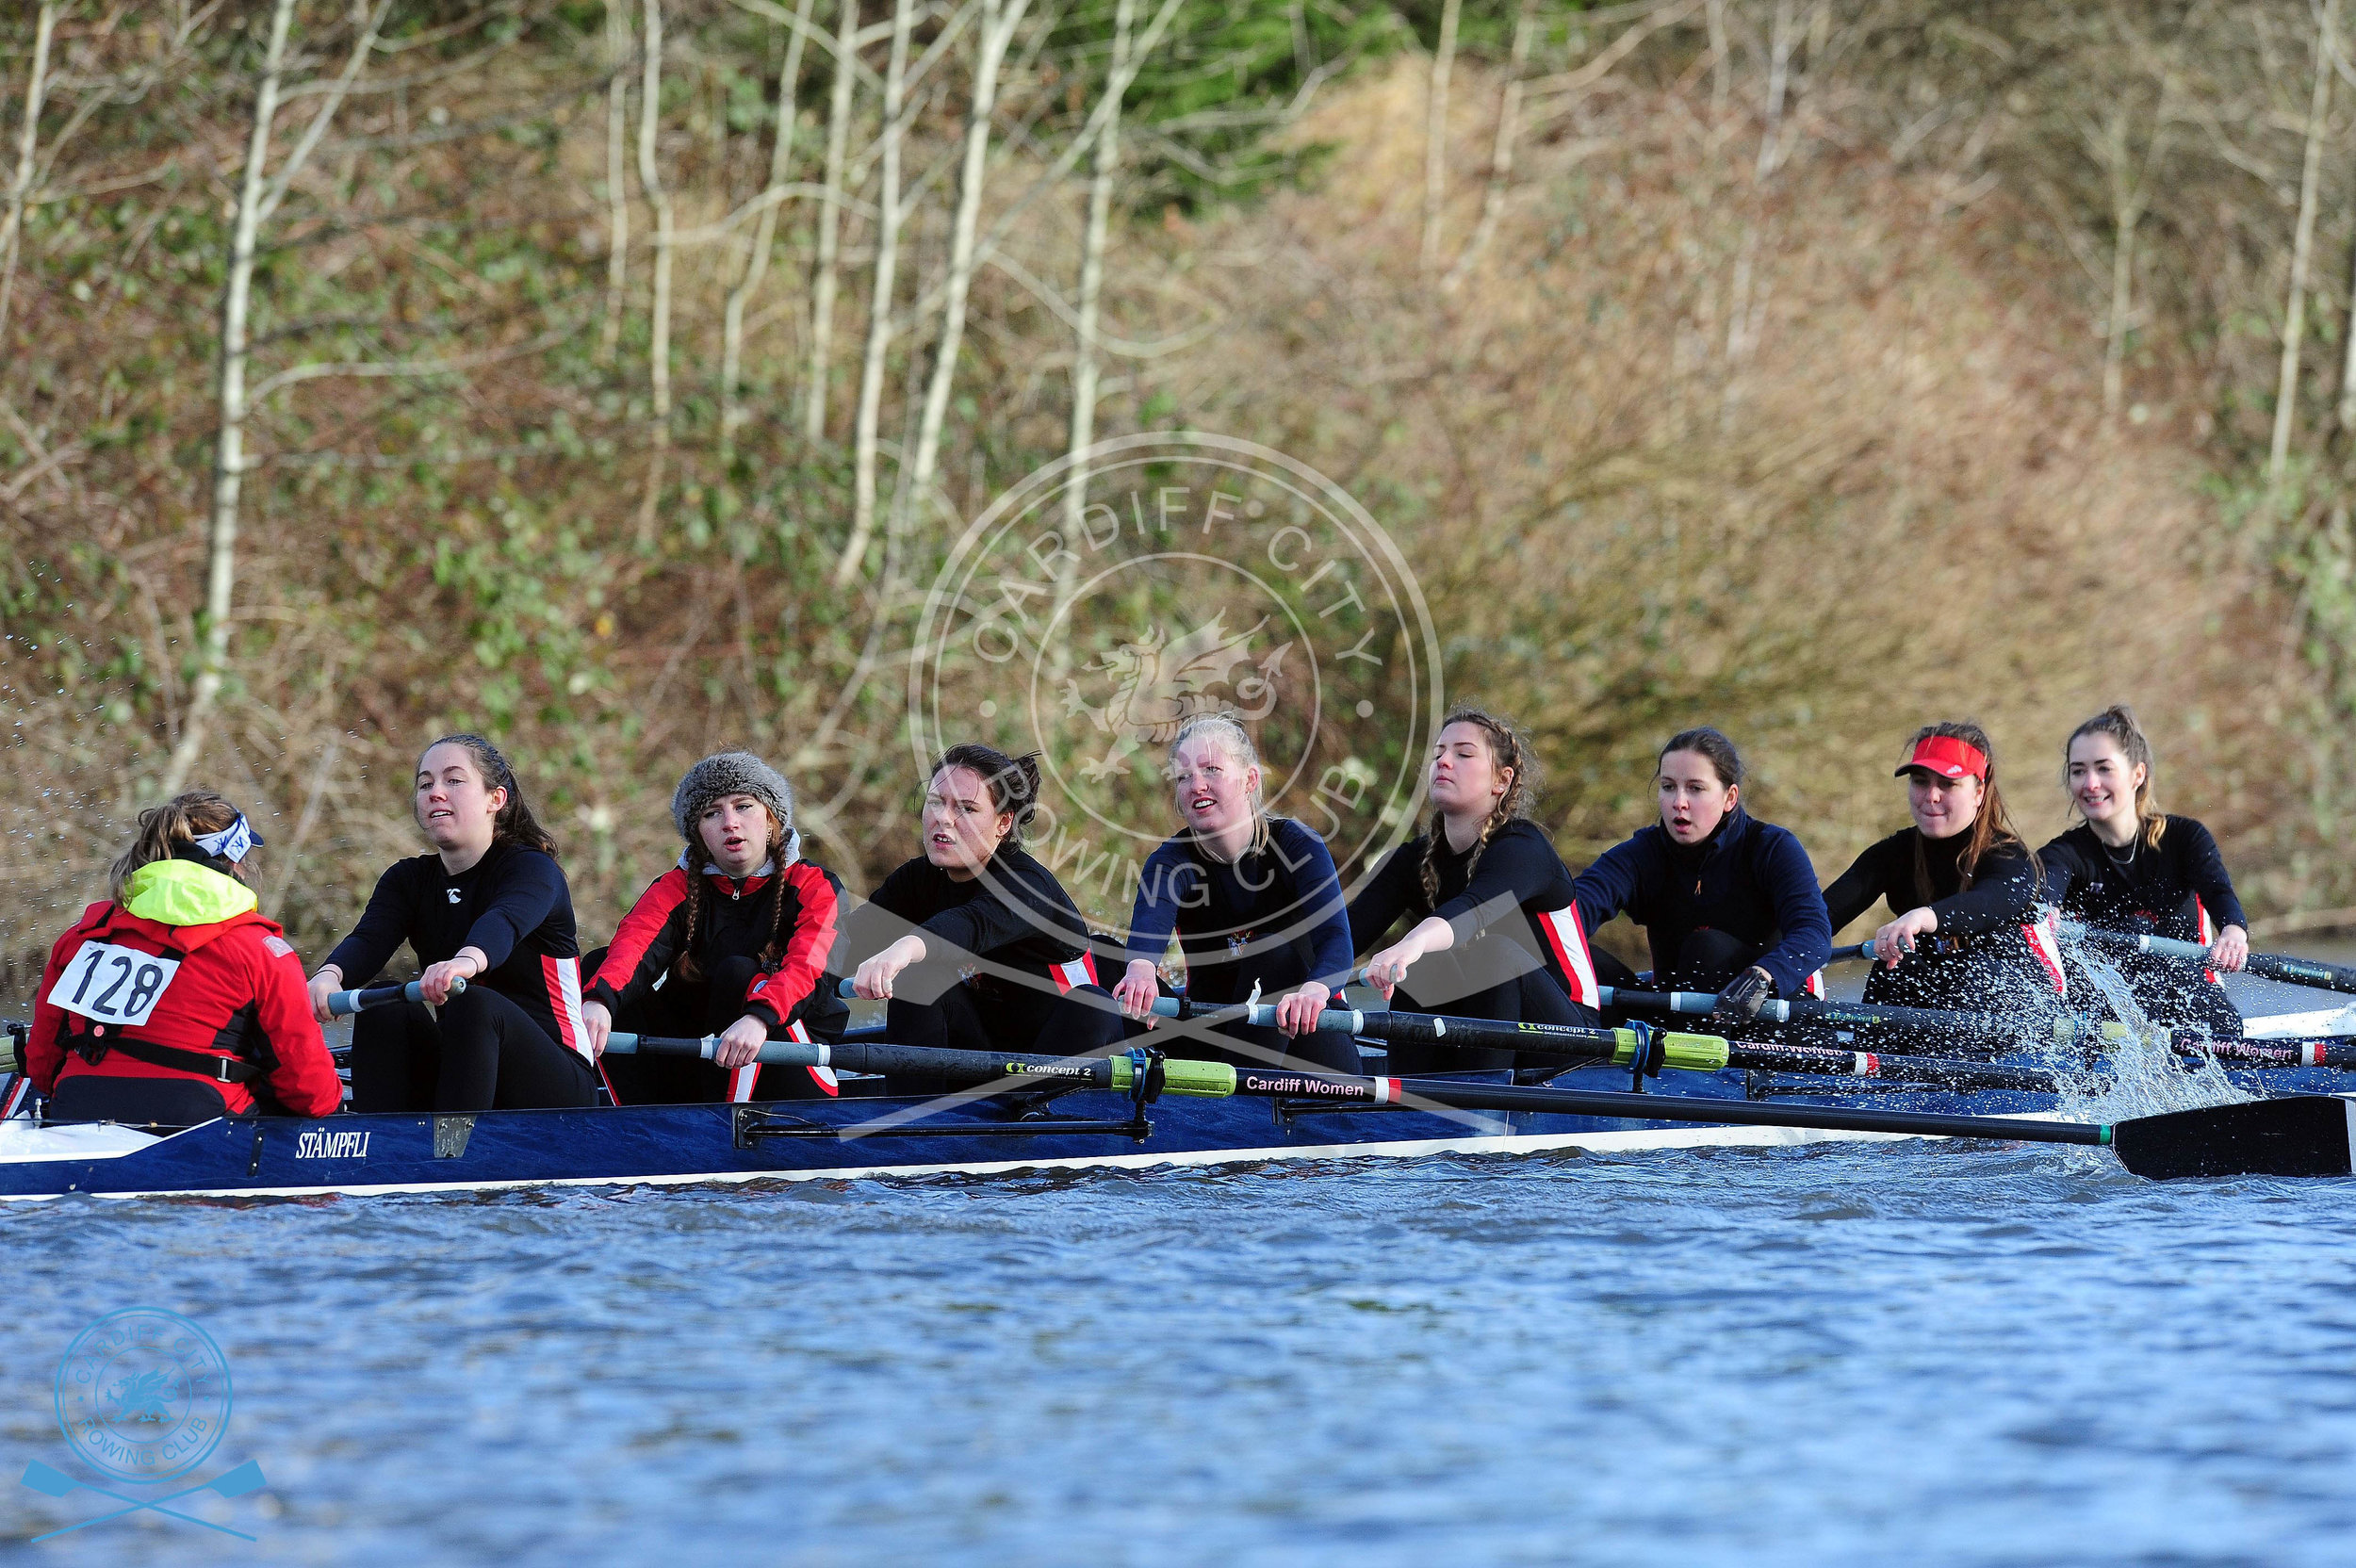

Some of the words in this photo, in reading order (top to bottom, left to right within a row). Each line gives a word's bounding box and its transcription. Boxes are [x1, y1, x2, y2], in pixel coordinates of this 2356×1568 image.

[72, 950, 163, 1018] 128
[1026, 1065, 1081, 1076] concept
[1083, 1068, 1091, 1076] 2
[1246, 1075, 1301, 1092] Cardiff
[1304, 1079, 1365, 1097] Women
[295, 1127, 371, 1159] STÄMPFLI
